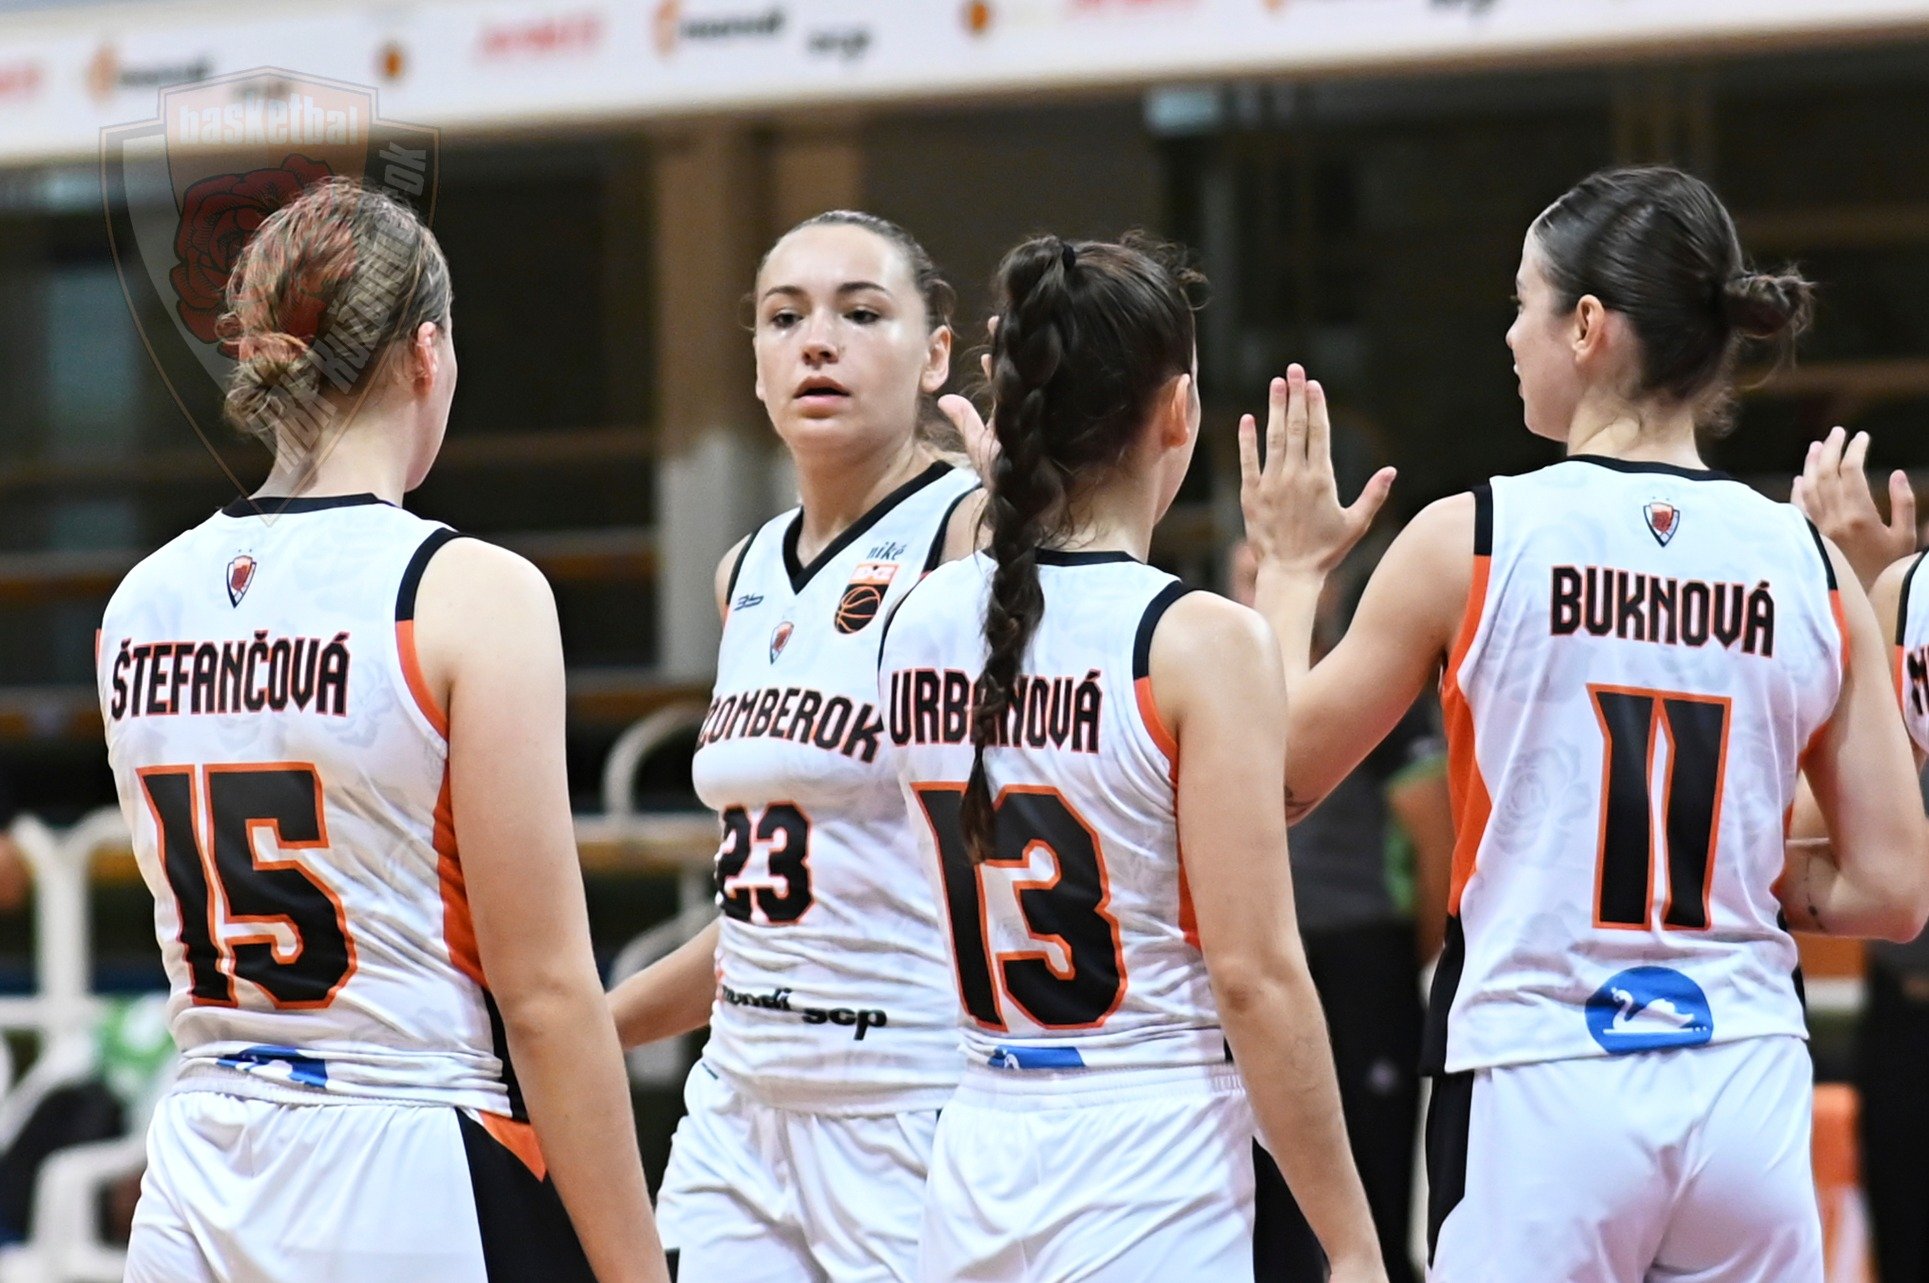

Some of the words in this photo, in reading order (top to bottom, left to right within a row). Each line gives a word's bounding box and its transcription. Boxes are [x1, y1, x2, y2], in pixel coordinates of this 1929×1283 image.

[1550, 565, 1775, 658] BUKNOVÁ
[110, 630, 350, 722] ŠTEFANČOVÁ
[717, 800, 815, 925] 23
[1585, 683, 1731, 932] 11
[136, 762, 358, 1010] 15
[909, 781, 1128, 1032] 13
[802, 1007, 887, 1041] scp
